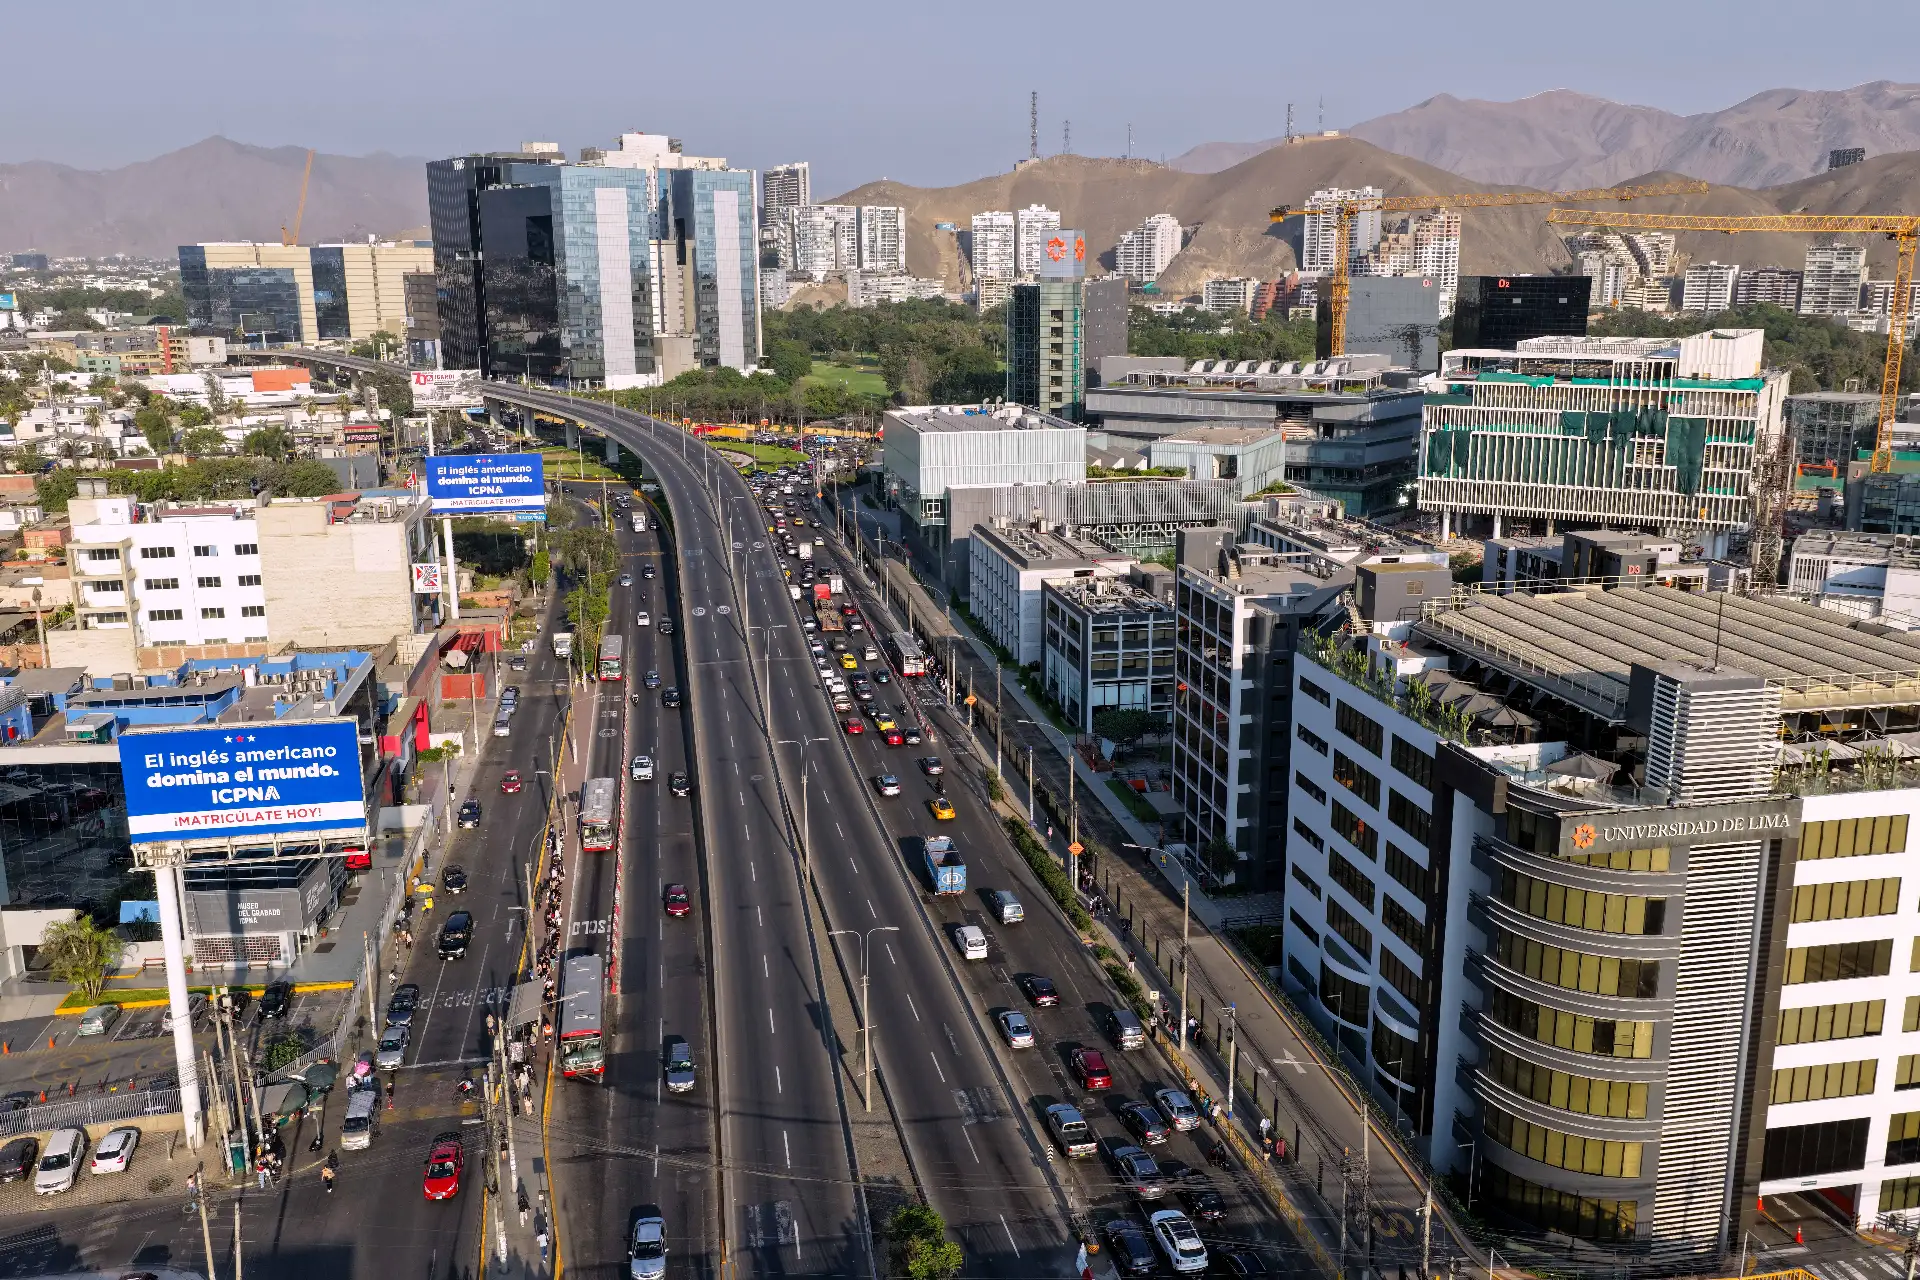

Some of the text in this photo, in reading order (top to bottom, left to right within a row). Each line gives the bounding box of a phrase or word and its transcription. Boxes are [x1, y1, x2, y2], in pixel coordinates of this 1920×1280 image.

[437, 465, 532, 476] El inglés americano
[438, 474, 532, 485] domina el mundo.
[469, 486, 503, 494] ICPNA
[145, 745, 337, 769] El inglés americano
[146, 762, 340, 788] domina el mundo.
[211, 785, 280, 804] ICPNA
[174, 807, 322, 827] ¡MATRICÚLATE HOY!
[1603, 814, 1790, 842] UNIVERSIDAD DE LIMA
